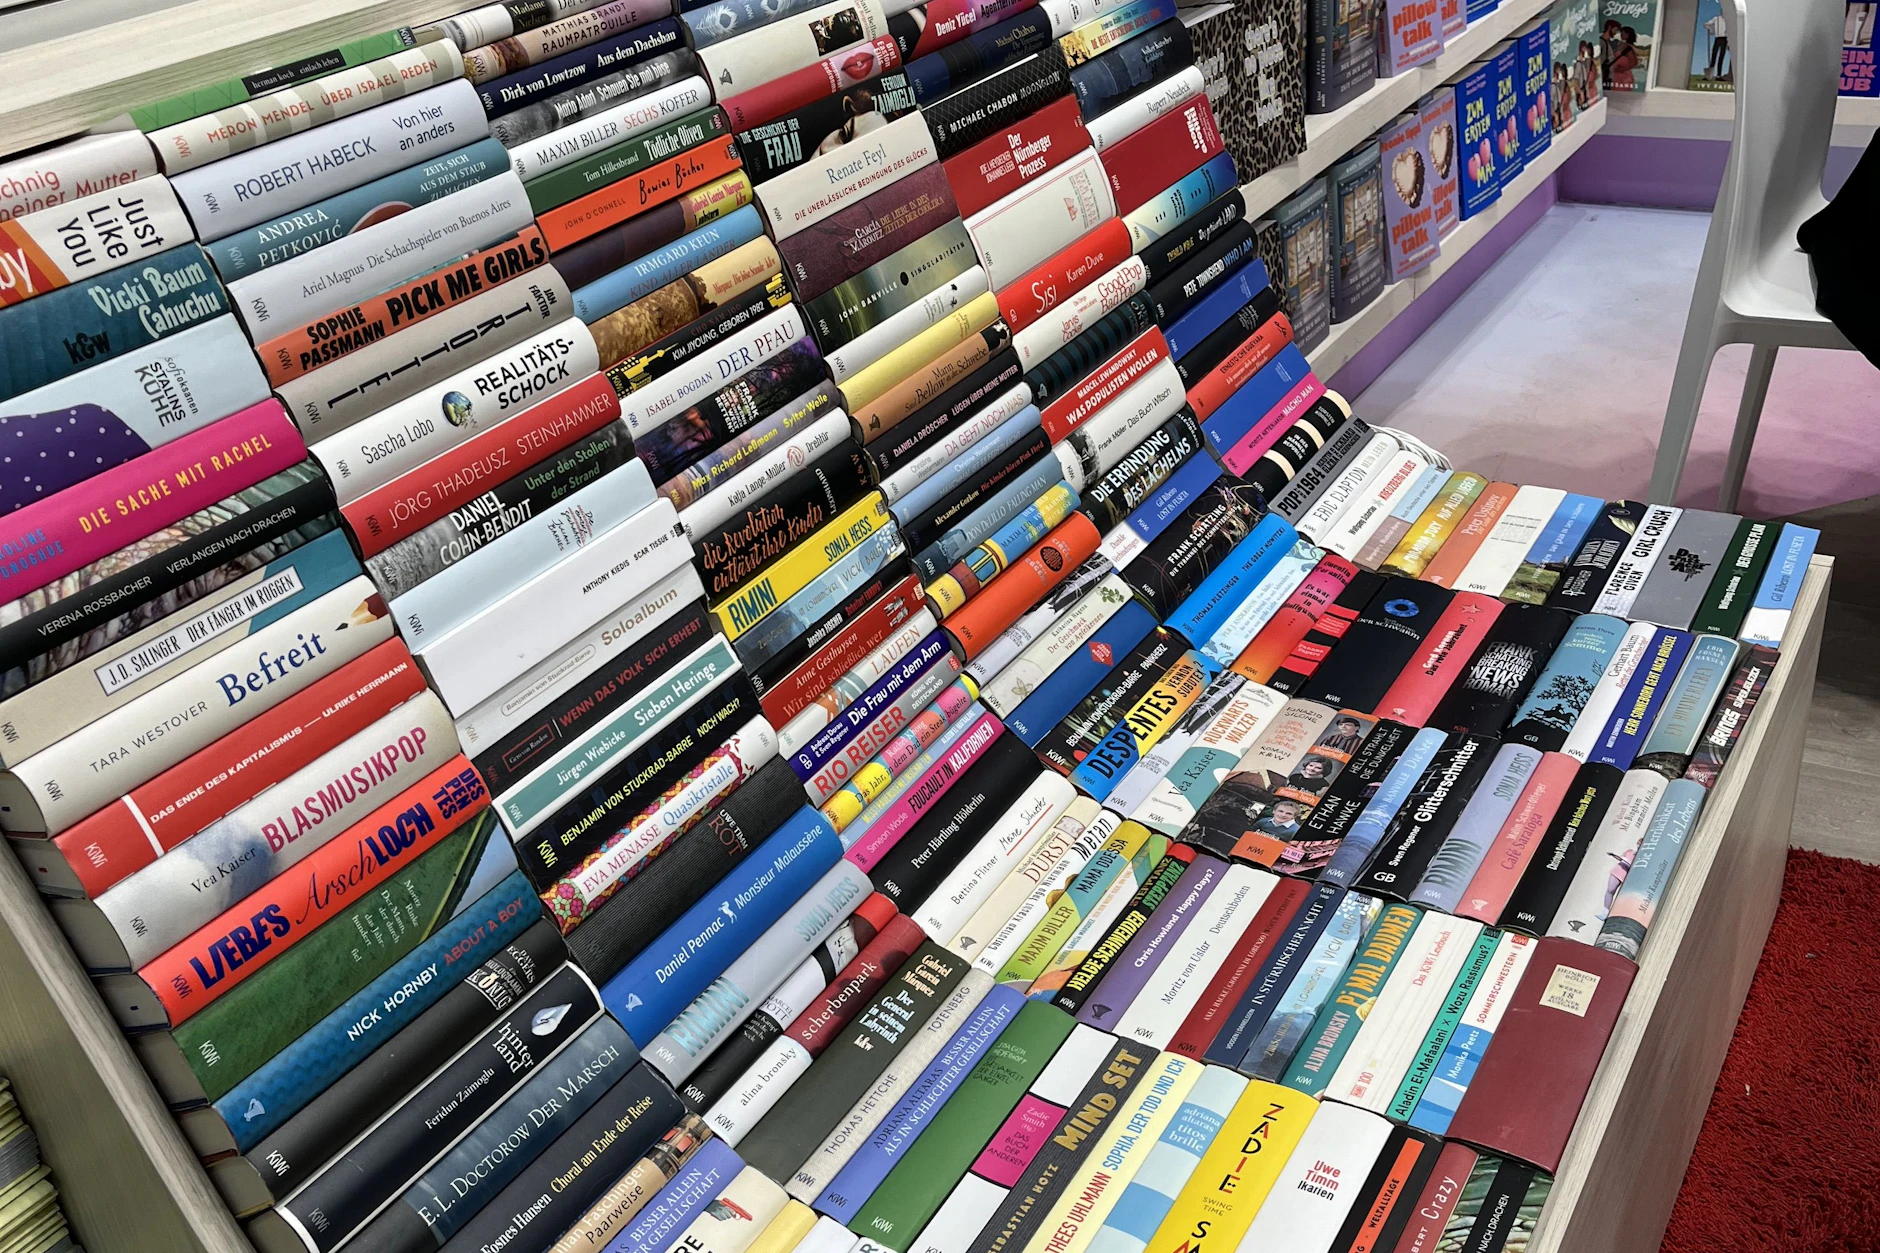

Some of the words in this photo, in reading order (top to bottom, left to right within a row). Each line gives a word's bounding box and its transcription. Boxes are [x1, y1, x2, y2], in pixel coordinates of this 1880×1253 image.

[542, 11, 638, 54] RAUMPATROUILLE
[935, 18, 957, 36] Deniz
[955, 8, 977, 28] Yücel
[1244, 16, 1278, 51] there's
[1393, 0, 1437, 35] pillow
[1402, 20, 1432, 48] talk
[251, 72, 276, 90] herman
[277, 69, 294, 82] koch
[299, 59, 322, 74] einfach
[322, 56, 339, 68] leben
[207, 118, 258, 143] MERON
[261, 102, 314, 129] MENDEL
[320, 86, 354, 106] ÜBER
[356, 74, 398, 95] ISRAEL
[401, 60, 438, 81] REDEN
[949, 108, 986, 133] MICHAEL
[986, 93, 1019, 117] CHABON
[1256, 97, 1284, 127] books
[1466, 97, 1484, 124] ZUM
[536, 138, 580, 166] MAXIM
[580, 121, 618, 148] BILLER
[623, 106, 658, 129] SECHS
[658, 89, 699, 115] KOFFER
[1008, 132, 1023, 149] Der
[1012, 134, 1052, 163] Nürnberger
[234, 162, 305, 202] ROBERT
[306, 136, 377, 175] HABECK
[763, 137, 803, 169] FRAU
[826, 156, 864, 184] Renate
[861, 143, 887, 169] Feyl
[1018, 157, 1047, 179] Prozess
[1476, 152, 1496, 188] MAL
[1392, 206, 1432, 245] pillow
[1401, 226, 1430, 255] talk
[634, 242, 691, 276] IRMGARD
[688, 229, 719, 254] KEUN
[88, 276, 152, 317] Vicki
[147, 260, 208, 297] Baum
[385, 282, 441, 327] PICK
[448, 262, 482, 300] ME
[483, 237, 546, 284] GIRLS
[1031, 275, 1058, 314] Sisi
[1066, 257, 1085, 284] Karen
[1084, 252, 1104, 274] Duve
[138, 290, 221, 338] Cahuchu
[306, 306, 366, 344] SOPHIE
[299, 320, 386, 371] PASSMANN
[473, 338, 575, 396] REALITÄTS-
[716, 347, 753, 380] DER
[753, 320, 795, 358] PFAU
[497, 361, 571, 411] SCHOCK
[646, 389, 677, 418] ISABEL
[676, 372, 713, 399] BOGDAN
[1066, 404, 1087, 425] WAS
[1085, 372, 1129, 411] POPULISTEN
[1127, 348, 1158, 378] WOLLEN
[1077, 378, 1099, 399] MARCEL
[1098, 348, 1138, 383] LEWANDOWSKY
[361, 431, 407, 465] Sascha
[407, 416, 435, 443] Lobo
[388, 491, 432, 529] JÖRG
[432, 447, 510, 498] THADEUSZ
[516, 391, 613, 456] STEINHAMMER
[78, 511, 112, 534] DIE
[116, 483, 172, 516] SACHE
[174, 462, 206, 487] MIT
[211, 433, 272, 471] RACHEL
[1091, 479, 1113, 502] DIE
[1112, 428, 1171, 487] ERFINDUNG
[1124, 481, 1146, 508] DES
[1142, 437, 1191, 489] LÄCHELNS
[439, 498, 533, 566] COHN-BENDIT
[449, 490, 506, 532] DANIEL
[1643, 509, 1672, 536] CRUSH
[582, 569, 610, 595] ANTHONY
[609, 559, 630, 578] KIEDIS
[633, 546, 649, 562] SCAR
[648, 533, 669, 552] TISSUE
[1631, 538, 1656, 558] GIRL
[1192, 603, 1213, 624] THOMAS
[1212, 575, 1240, 604] PLETZINGER
[1605, 561, 1634, 596] FLORENCE
[1623, 571, 1644, 591] GIVEN
[108, 662, 132, 686] J.D.
[131, 636, 182, 672] SALINGER
[186, 621, 207, 643] DER
[208, 604, 245, 632] FÄNGER
[244, 594, 259, 611] IM
[256, 578, 296, 605] ROGGEN
[601, 586, 679, 646] Soloalbum
[216, 629, 327, 707] Befreit
[89, 748, 130, 774] TARA
[132, 701, 209, 749] WESTOVER
[556, 757, 587, 786] Jürgen
[585, 728, 626, 762] Wiebicke
[634, 692, 675, 727] Sieben
[671, 659, 717, 698] Heringe
[1203, 699, 1249, 745] RÜCKWÄRTS
[1225, 712, 1259, 744] WALZER
[1709, 708, 1741, 747] BRINGS
[814, 759, 848, 798] RIO
[849, 706, 906, 762] REISER
[1168, 780, 1193, 796] Vea
[1184, 749, 1217, 780] Kaiser
[261, 726, 428, 854] BLASMUSIKPOP
[662, 760, 735, 826] Quasikristalle
[1414, 739, 1480, 822] Glitterschnitter
[1307, 795, 1342, 831] ETHAN
[1326, 799, 1361, 834] HAWKE
[1388, 845, 1404, 868] Sven
[1401, 824, 1422, 854] Regener
[1499, 848, 1518, 873] Café
[1517, 814, 1543, 853] Saratoga
[654, 946, 691, 984] Daniel
[689, 916, 726, 954] Pennac
[734, 863, 776, 909] Monsieur
[773, 824, 824, 874] Malaussène
[346, 1011, 382, 1042] NICK
[383, 962, 440, 1013] HORNBY
[926, 986, 971, 1034] TOTENBERG
[1477, 952, 1520, 1025] SOMMERSCHWESTERN
[492, 1037, 524, 1073] land
[497, 1020, 536, 1070] hinter
[739, 1079, 764, 1108] alina
[762, 1046, 798, 1085] bronsky
[800, 959, 878, 1041] scherbenpark
[1305, 1041, 1330, 1073] ALINA
[1320, 1010, 1351, 1051] BRONSKY
[1053, 1091, 1118, 1152] MIND
[1102, 1048, 1144, 1089] SET
[417, 1206, 440, 1228] E.
[437, 1187, 456, 1211] L.
[451, 1123, 531, 1198] DOCTOROW
[527, 1098, 563, 1129] DER
[557, 1044, 621, 1102] MARSCH
[1169, 1132, 1204, 1151] brille
[1177, 1124, 1208, 1141] titos
[1297, 1180, 1335, 1201] Ikarien
[1304, 1169, 1340, 1191] Timm
[1313, 1159, 1341, 1178] Uwe
[1367, 1177, 1400, 1229] WELTALLTAGE
[1420, 1175, 1459, 1220] Crazy
